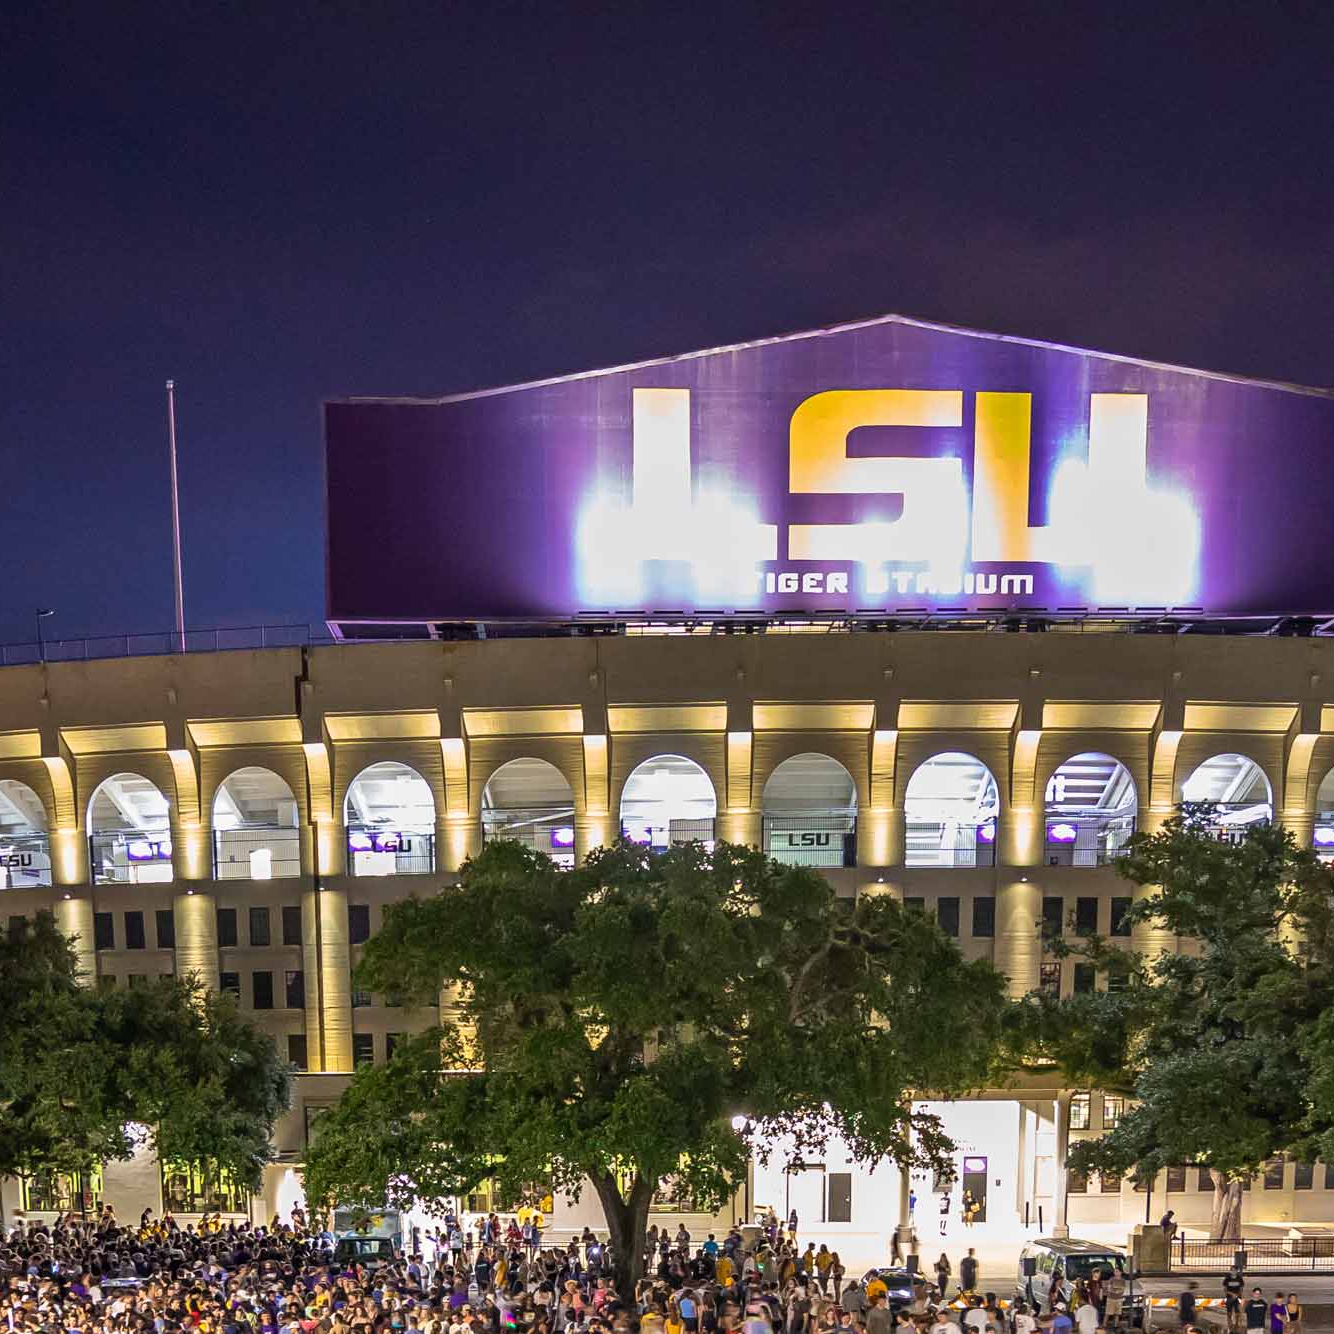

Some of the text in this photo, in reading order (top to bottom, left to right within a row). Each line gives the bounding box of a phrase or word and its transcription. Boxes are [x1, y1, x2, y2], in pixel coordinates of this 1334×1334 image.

[633, 388, 1149, 562] LSU
[865, 571, 1034, 595] STAIUM
[788, 832, 830, 847] LSU
